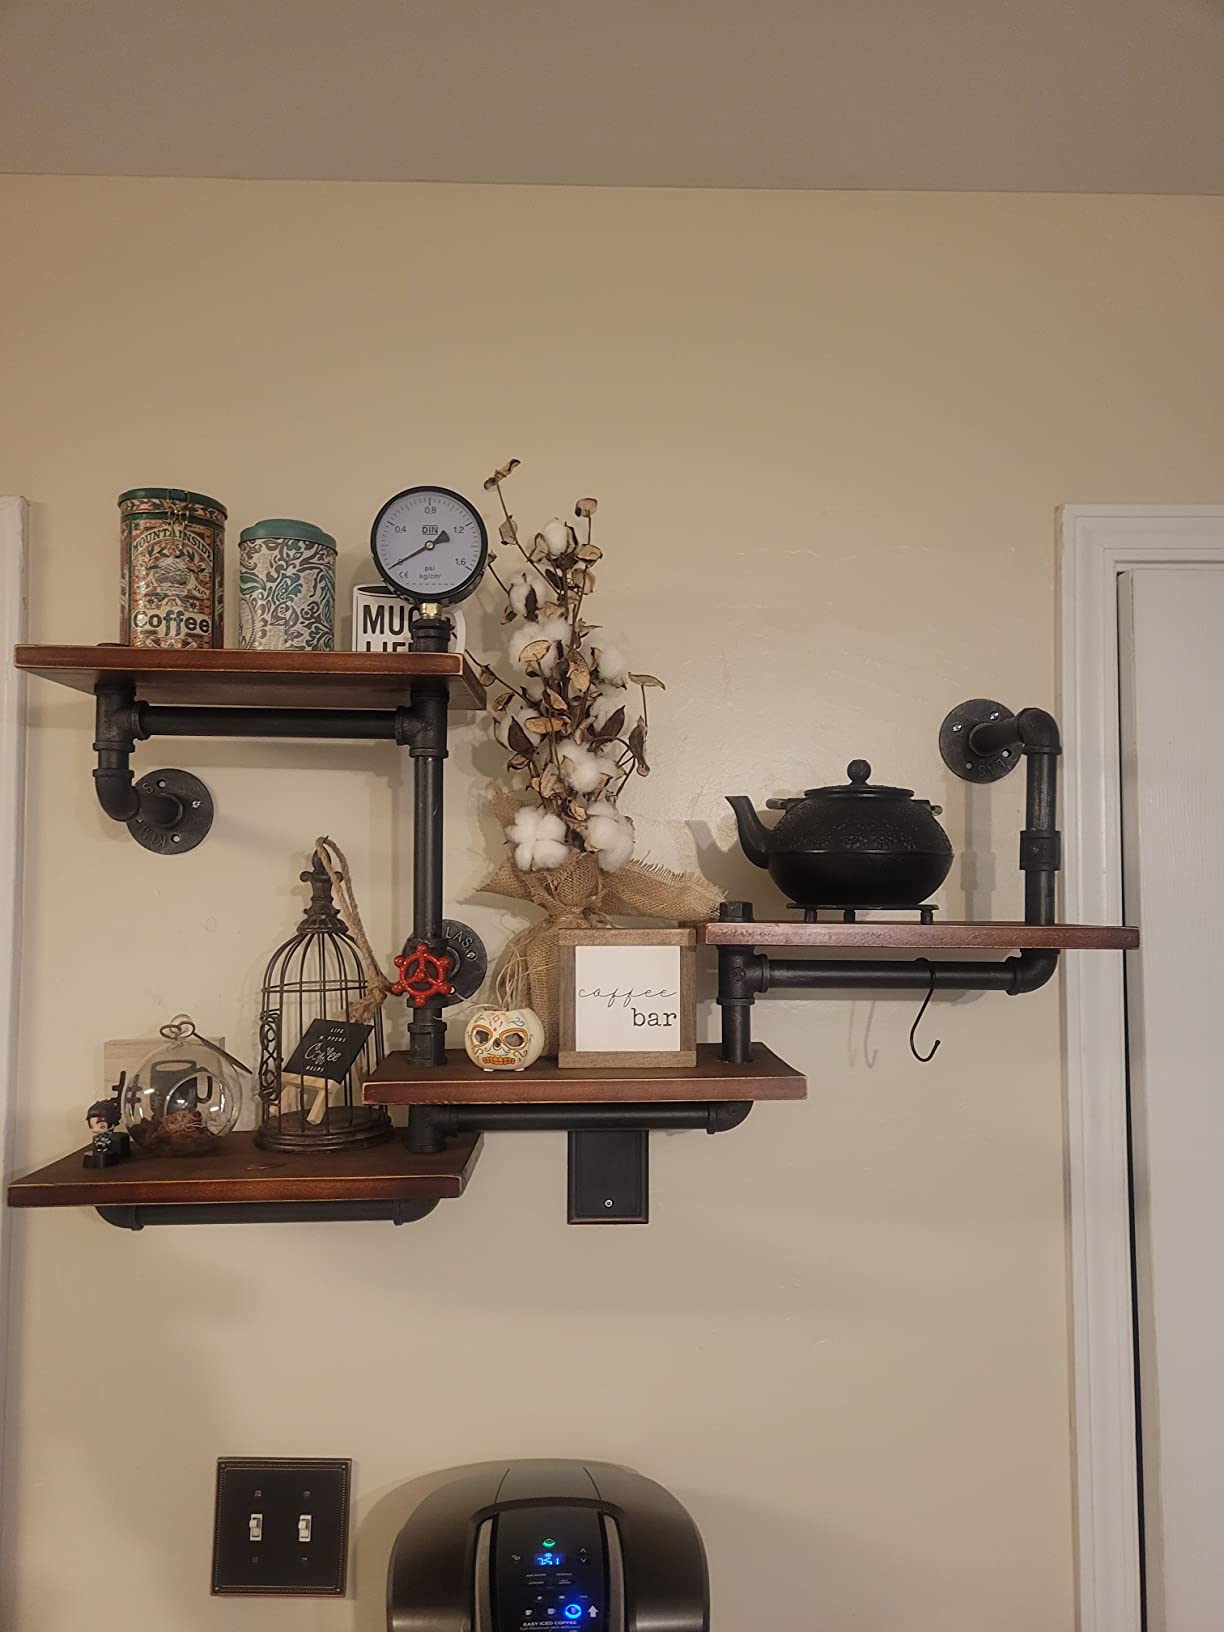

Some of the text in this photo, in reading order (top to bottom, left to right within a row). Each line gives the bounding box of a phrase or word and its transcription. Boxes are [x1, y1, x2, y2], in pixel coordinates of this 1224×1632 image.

[394, 525, 407, 534] 0.4
[421, 525, 439, 535] DIN
[132, 528, 213, 562] MOUNTAINSIDE
[455, 557, 466, 566] 1.6
[133, 609, 210, 637] Coffee
[578, 987, 678, 1008] coffee
[631, 1007, 677, 1027] bar
[319, 1035, 347, 1043] HPPENS
[304, 1042, 342, 1065] Coffee
[537, 1557, 560, 1566] 7:51
